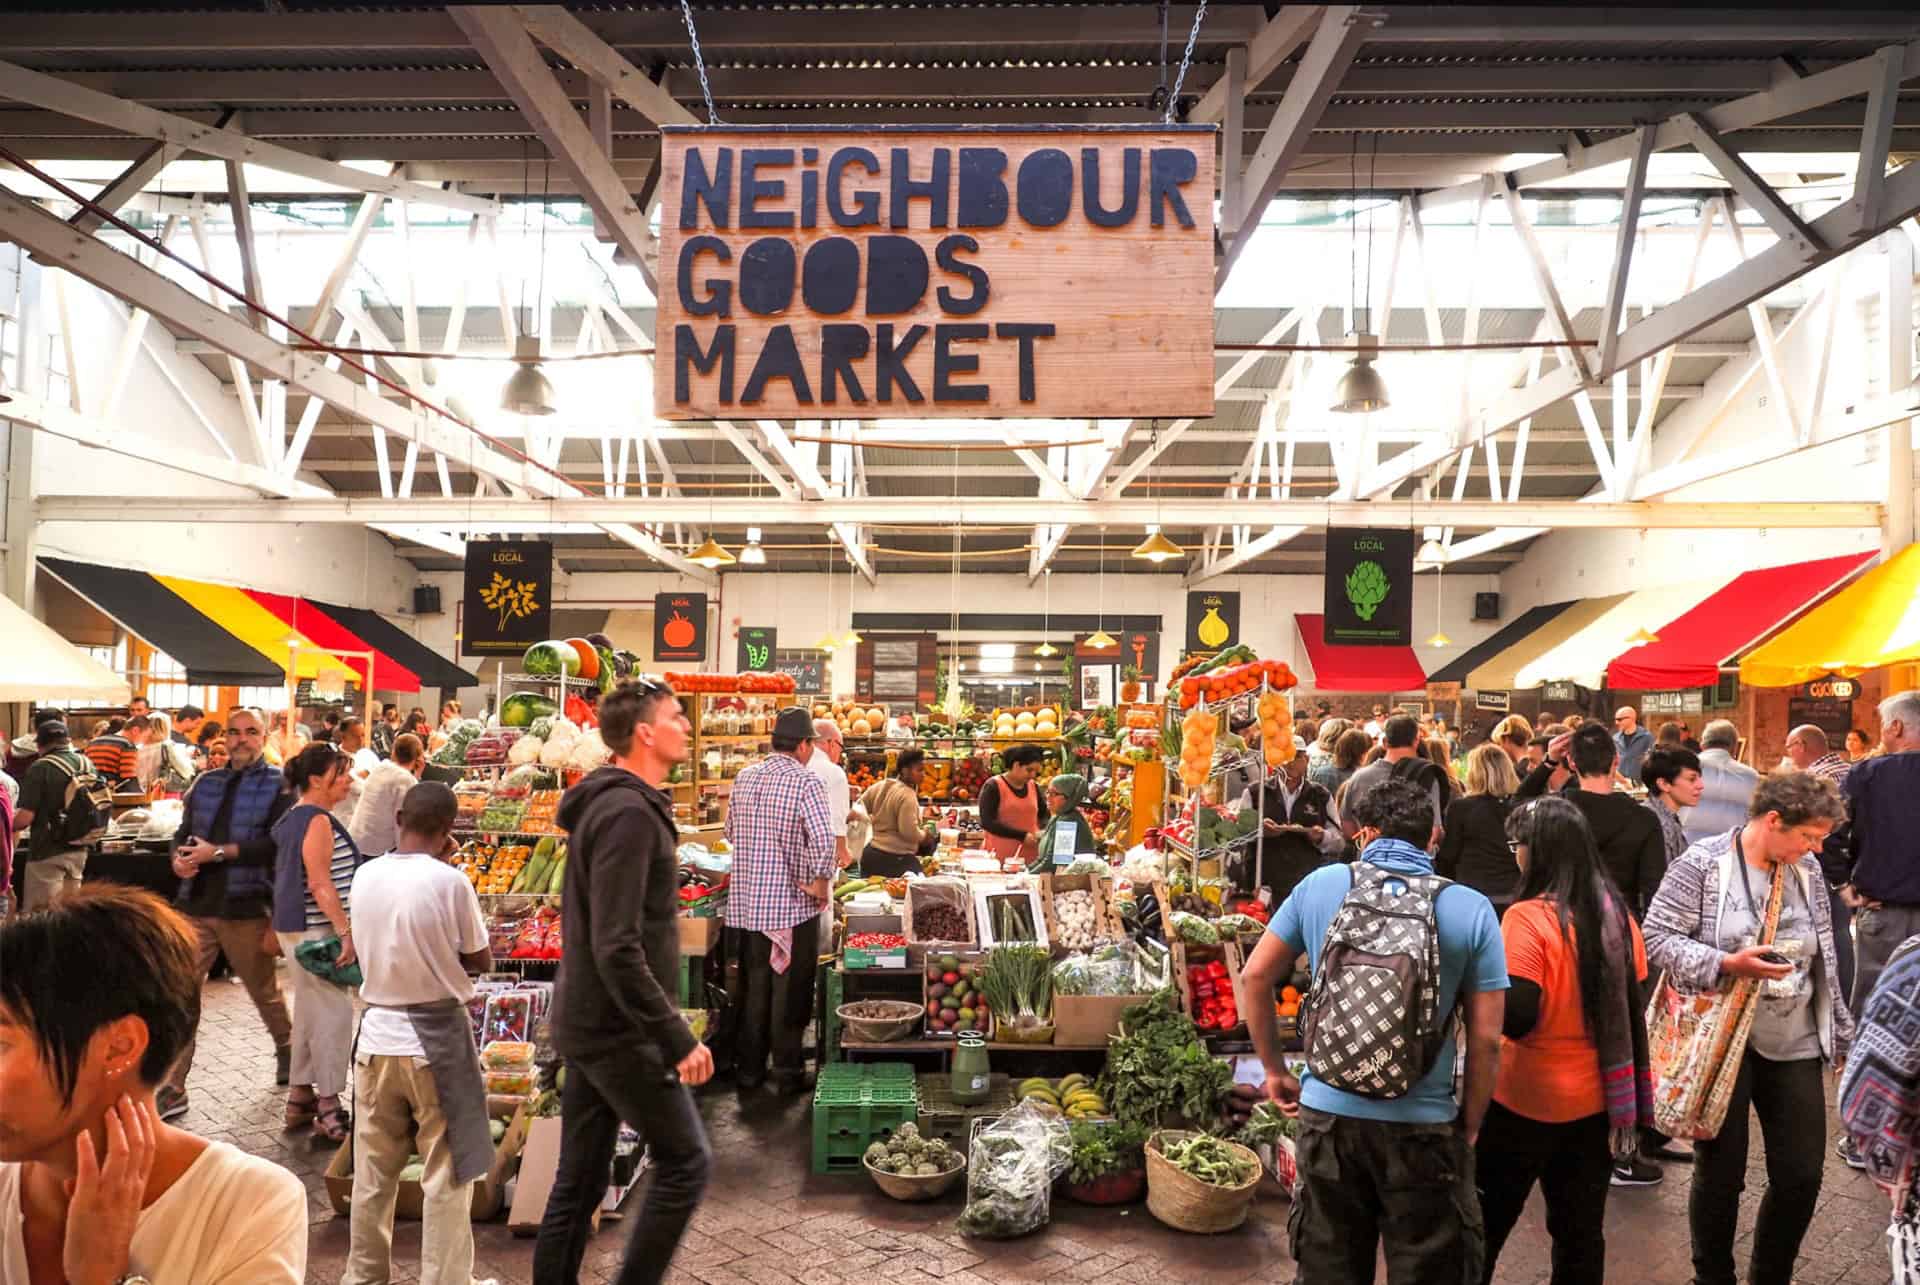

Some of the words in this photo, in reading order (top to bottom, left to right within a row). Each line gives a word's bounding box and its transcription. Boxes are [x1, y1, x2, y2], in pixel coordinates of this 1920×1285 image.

[677, 235, 990, 317] GOODS
[674, 323, 1056, 404] MARKET
[1354, 540, 1384, 550] LOCAL
[492, 552, 524, 562] LOCAL
[1810, 682, 1853, 697] COOKED
